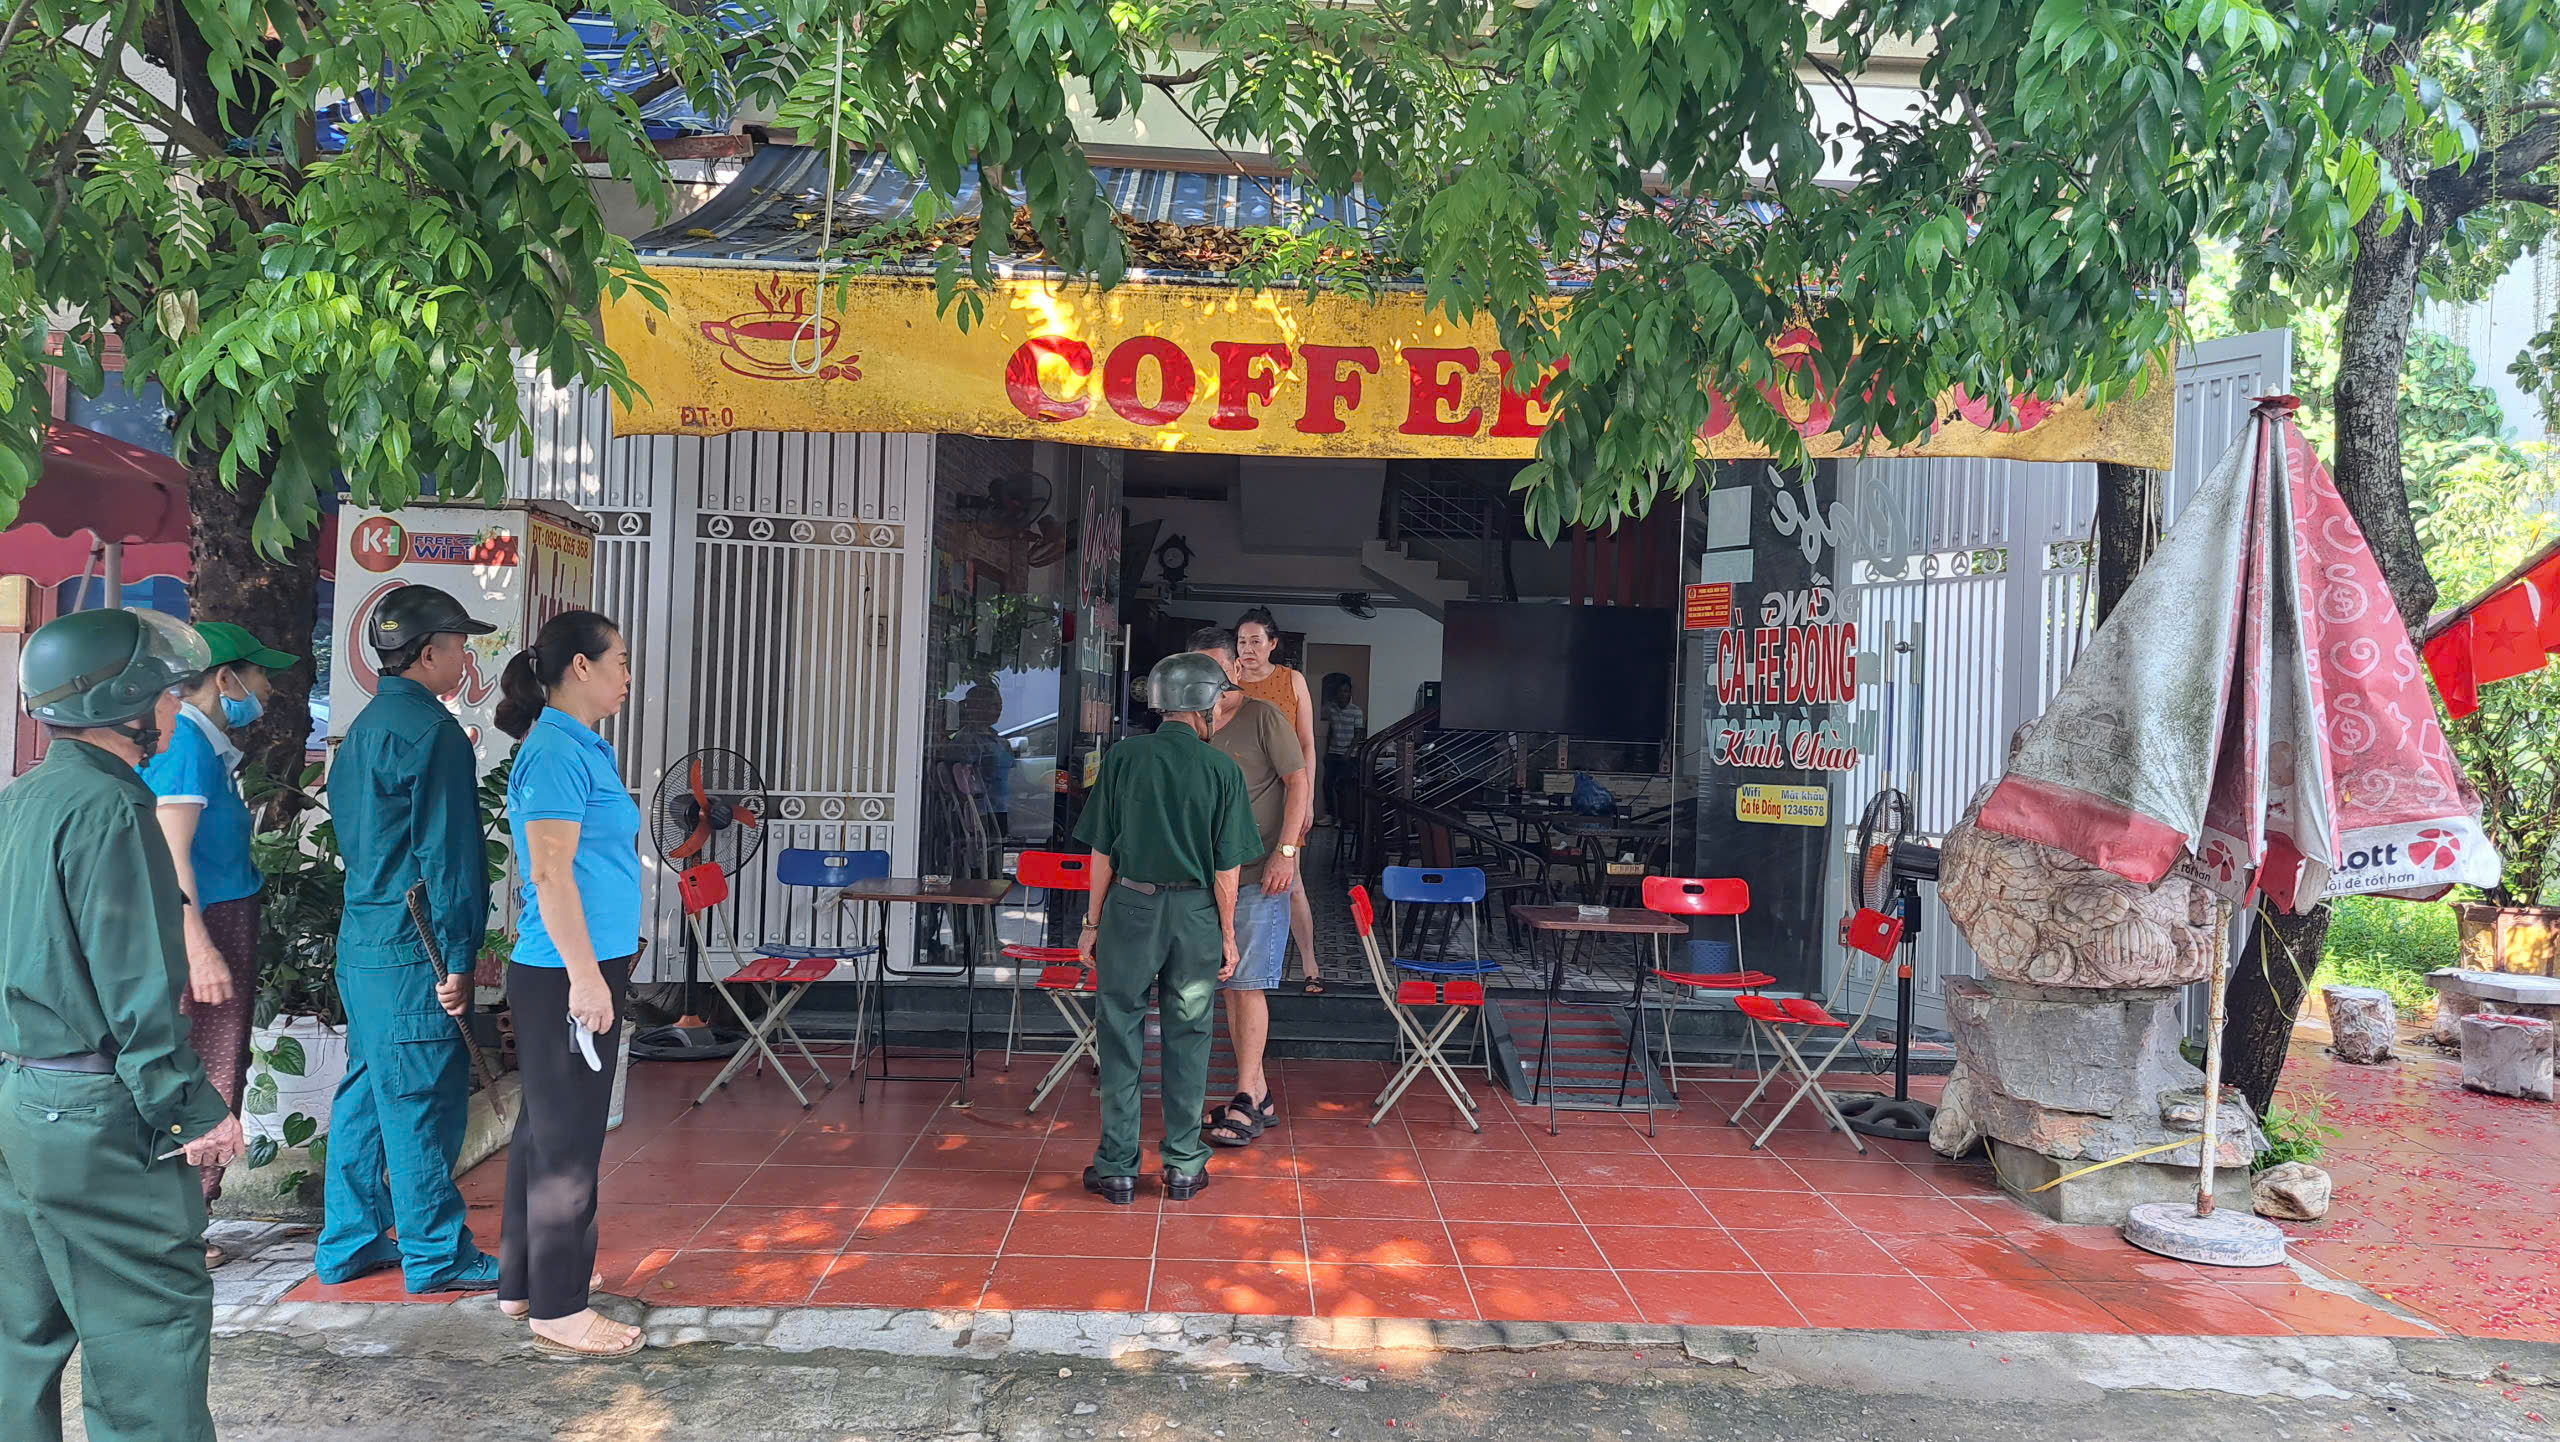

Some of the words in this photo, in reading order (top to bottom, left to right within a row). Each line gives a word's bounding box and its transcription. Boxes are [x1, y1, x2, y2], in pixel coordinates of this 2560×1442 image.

[1005, 335, 1573, 438] COFFEE
[414, 536, 453, 545] FREE
[413, 545, 472, 560] WiFi
[1717, 607, 1748, 706] CÀ
[1713, 727, 1785, 769] Kính
[1790, 729, 1861, 772] Chào
[1742, 786, 1761, 797] Wifi
[1783, 804, 1825, 816] 12345678
[2387, 872, 2415, 884] hơn
